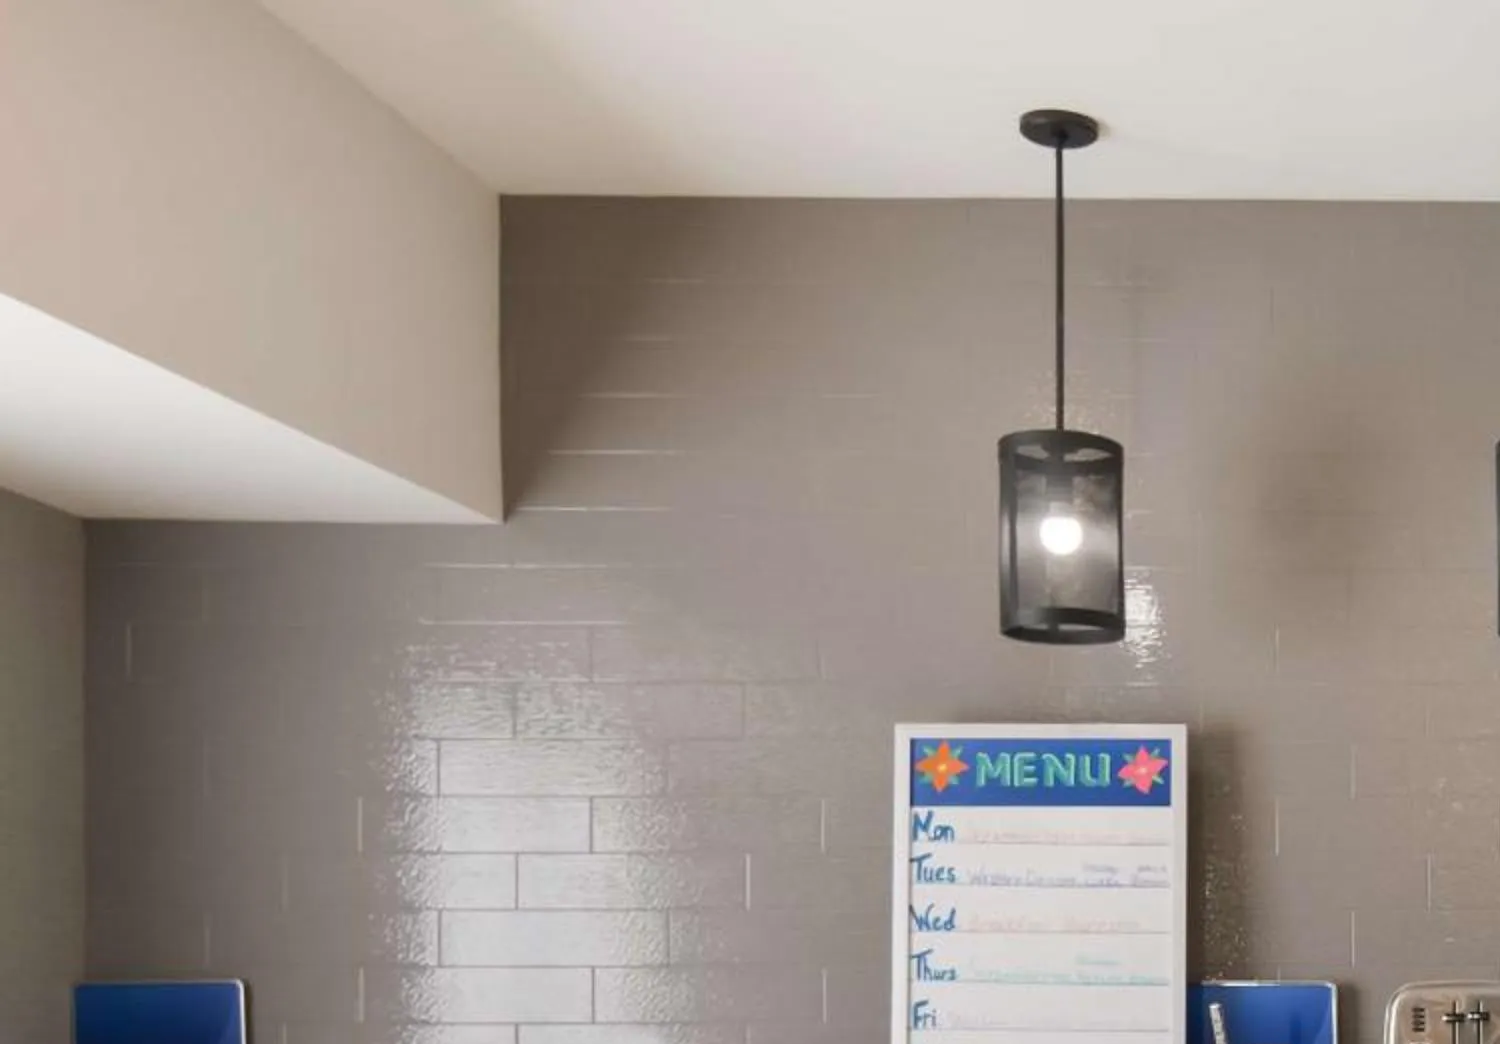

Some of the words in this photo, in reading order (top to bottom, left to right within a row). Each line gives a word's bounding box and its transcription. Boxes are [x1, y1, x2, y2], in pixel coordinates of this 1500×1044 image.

[975, 751, 1111, 788] MENU
[912, 810, 955, 842] Mon
[909, 852, 957, 884] Tues
[909, 902, 956, 932] Wed
[911, 949, 957, 982] Thurs
[912, 1000, 937, 1030] Fri
